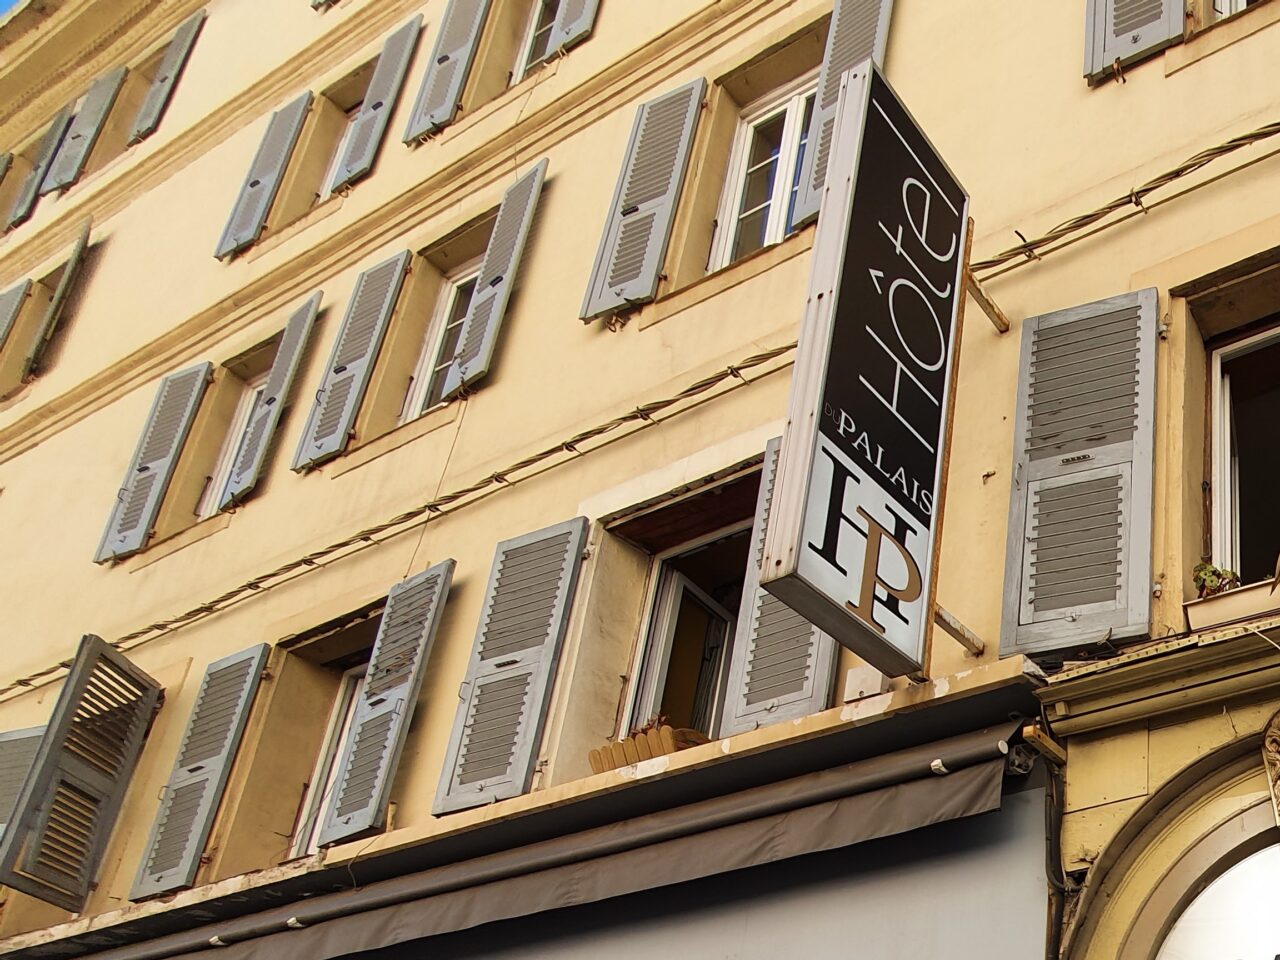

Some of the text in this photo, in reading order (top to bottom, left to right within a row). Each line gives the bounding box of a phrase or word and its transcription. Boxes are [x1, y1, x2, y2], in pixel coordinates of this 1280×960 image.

[858, 97, 960, 454] Hôtel
[824, 402, 933, 515] DU PALAIS
